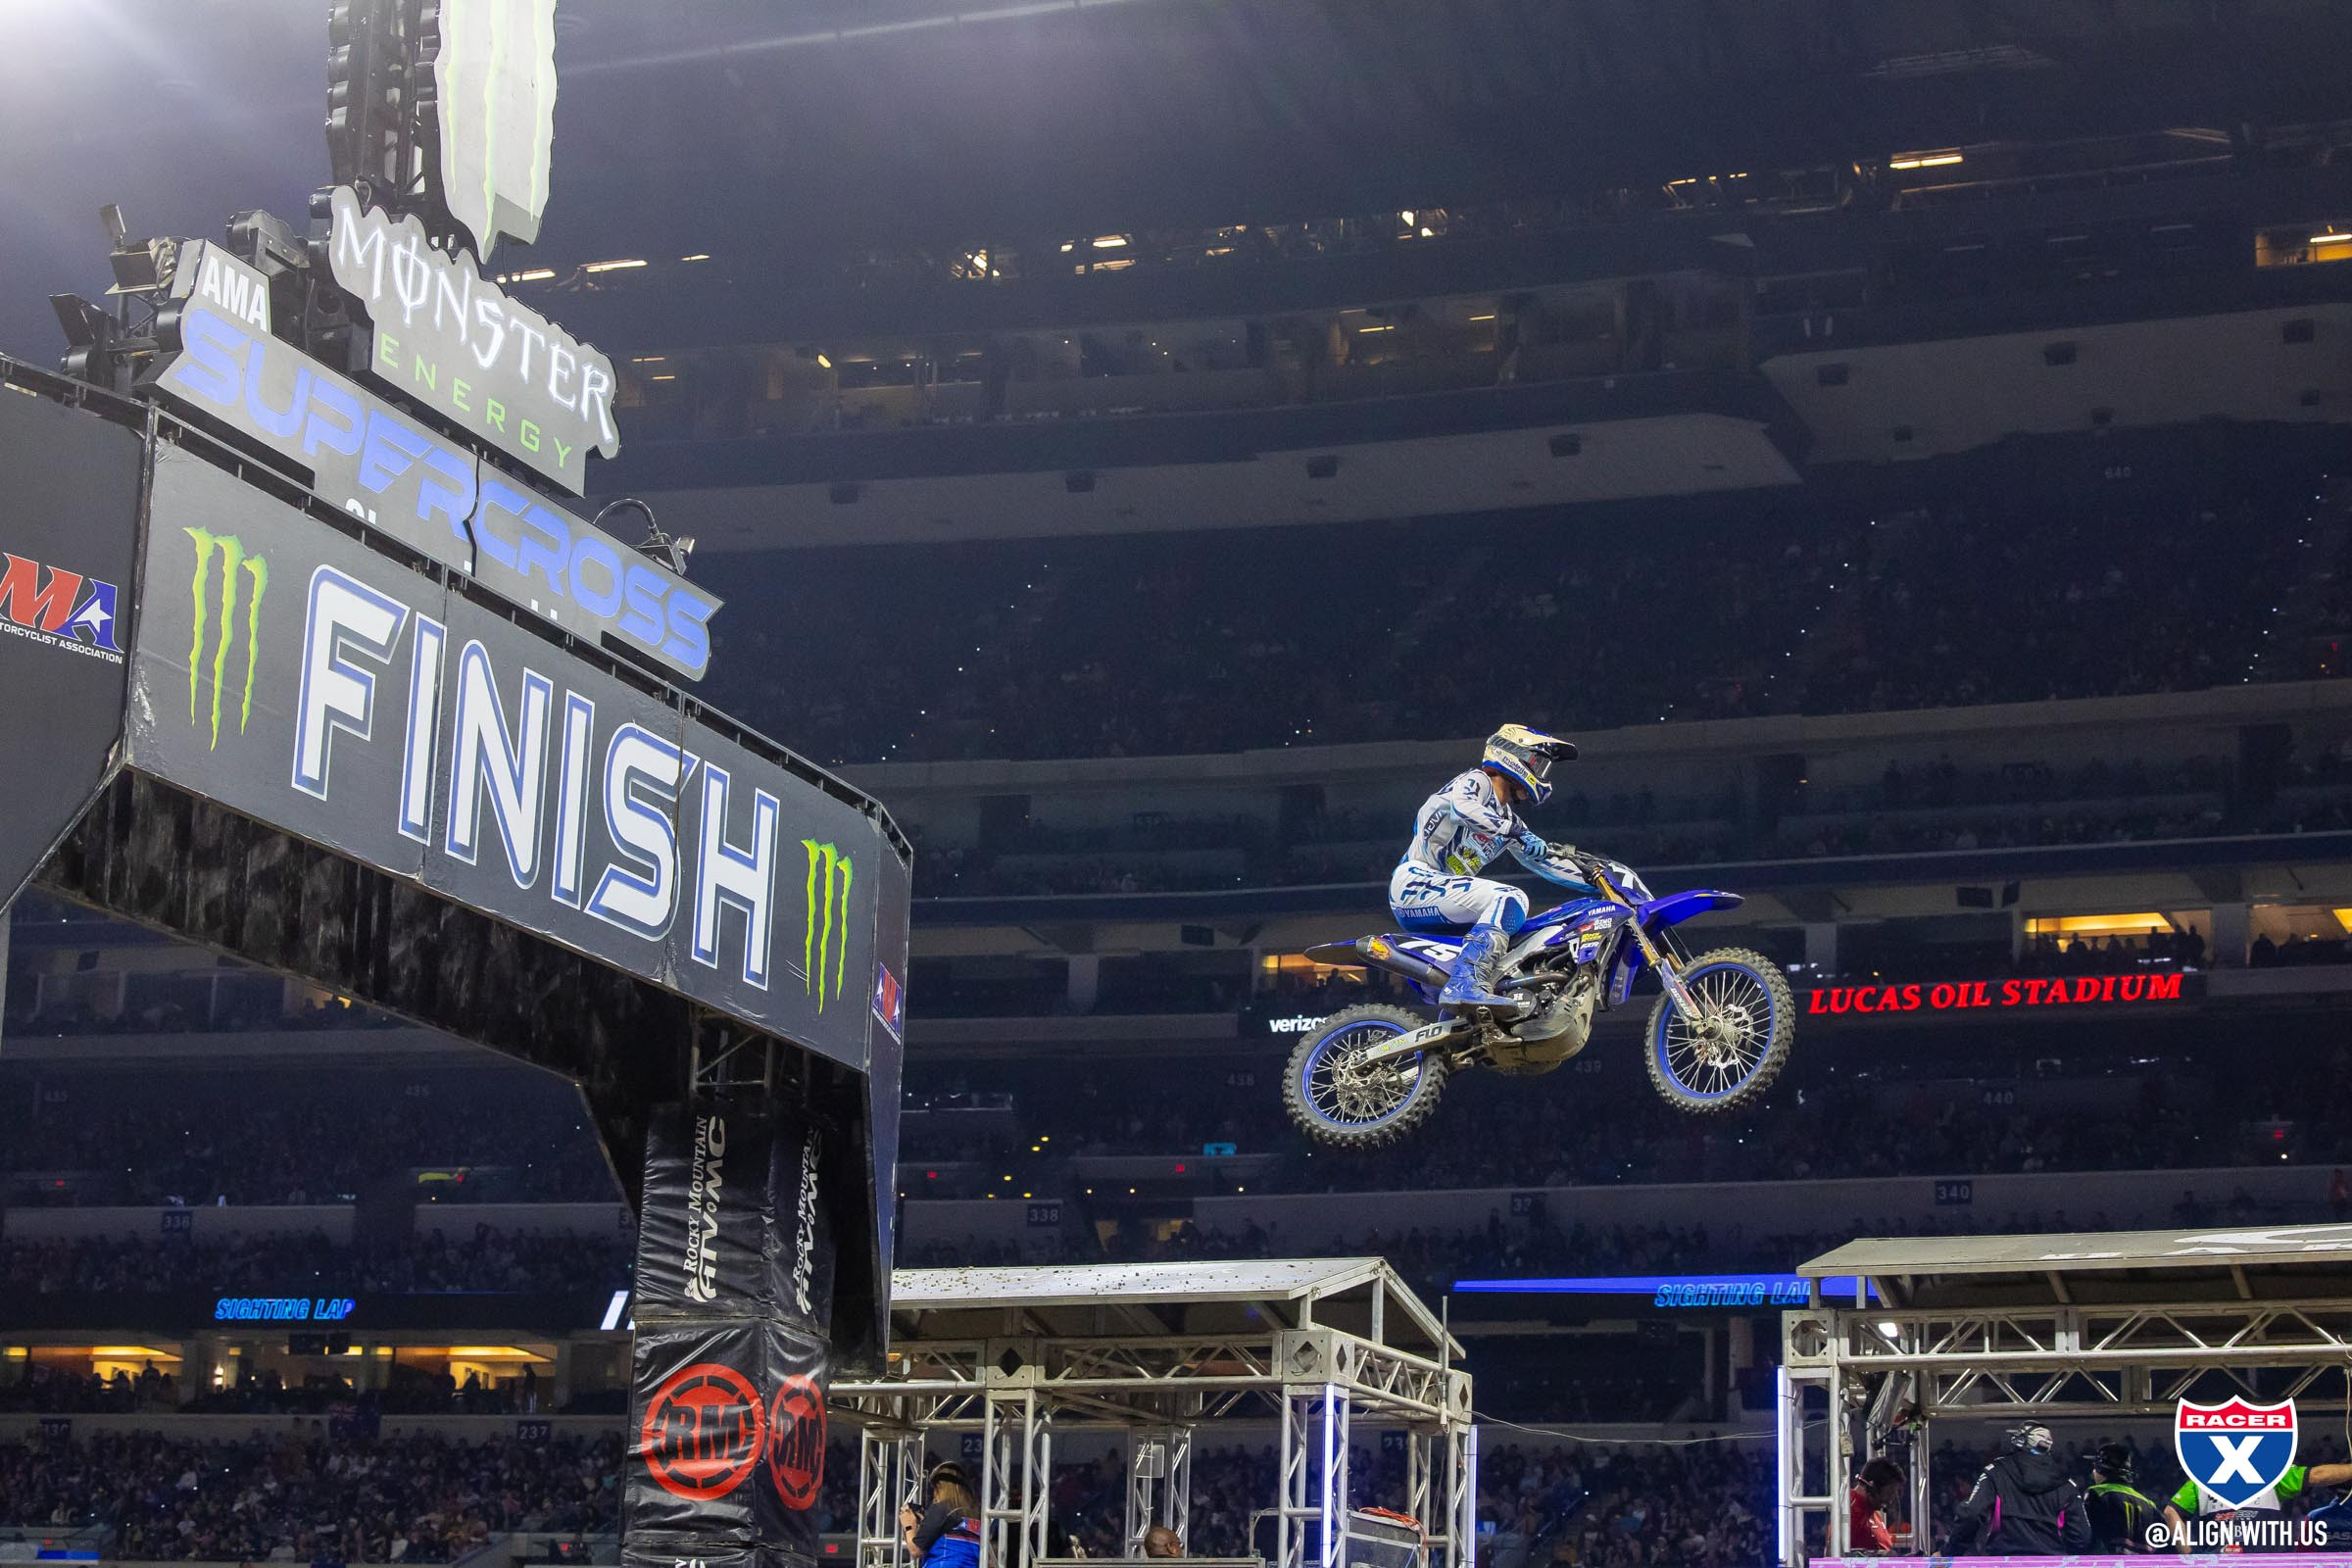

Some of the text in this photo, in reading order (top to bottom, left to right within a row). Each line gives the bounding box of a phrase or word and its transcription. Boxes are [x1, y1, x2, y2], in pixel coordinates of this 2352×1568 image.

[201, 256, 270, 332] AMA
[336, 204, 615, 445] MONSTER
[380, 332, 572, 468] ENERGY
[173, 309, 711, 670] SUPERCROSS
[0, 552, 124, 654] MA
[59, 640, 123, 664] ASSOCIATION
[292, 564, 780, 991] FINISH
[1404, 906, 1441, 918] YAMAHA
[1588, 905, 1616, 916] YAMAHA
[1397, 940, 1463, 962] 75
[1809, 974, 2183, 1014] LUCAS OIL STADIUM
[1269, 1014, 1328, 1033] verizo
[683, 1115, 707, 1274] ROCKY MOUNTAIN
[1937, 1184, 1969, 1200] 340
[1030, 1208, 1059, 1222] 338
[793, 1223, 806, 1284] ROCKY
[1654, 1283, 1765, 1307] SIGHTING
[214, 1298, 356, 1320] SIGHTING LAP
[519, 1426, 549, 1440] 237
